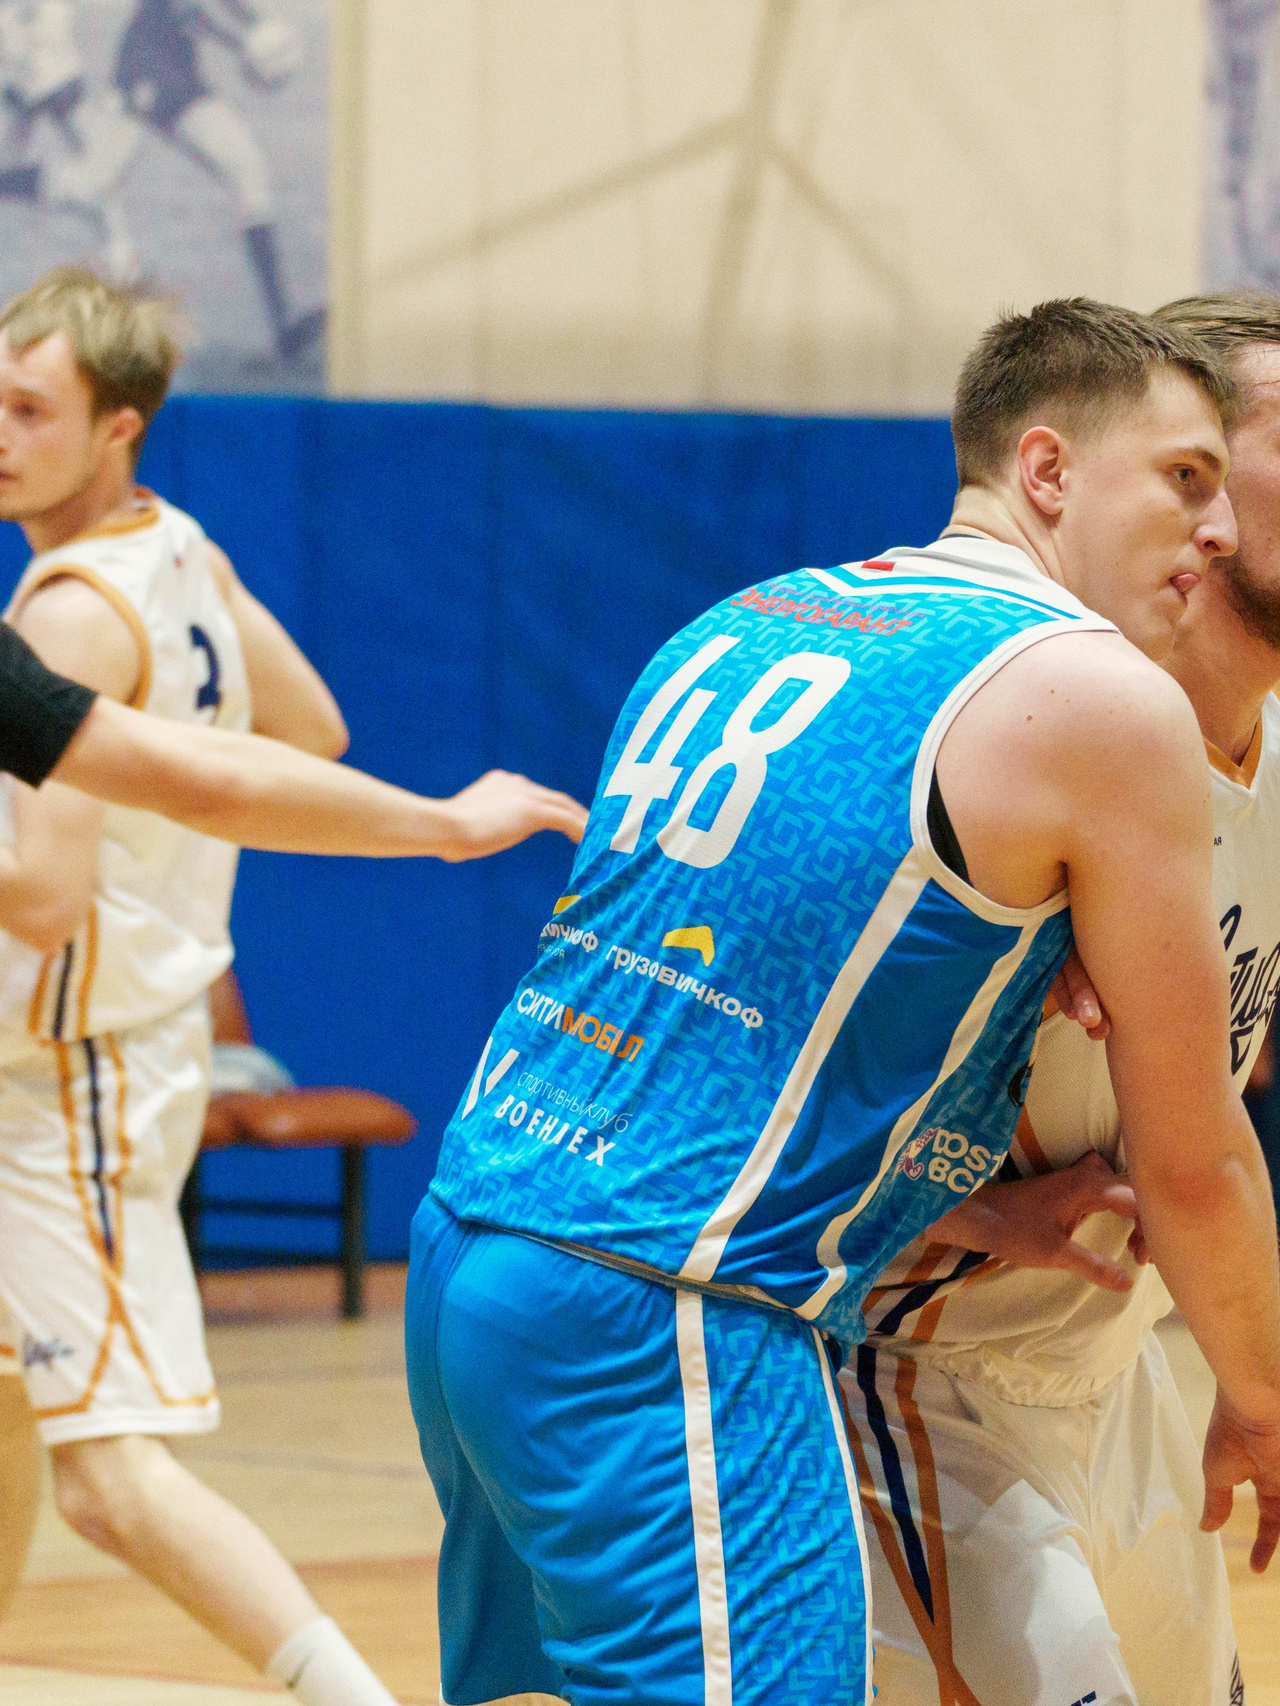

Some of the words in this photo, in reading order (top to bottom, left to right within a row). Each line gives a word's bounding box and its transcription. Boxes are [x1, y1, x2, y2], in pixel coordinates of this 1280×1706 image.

[729, 588, 913, 637] ЭНЕРГОГАРАНТ
[602, 633, 852, 869] 48
[605, 944, 764, 1029] грузовичкоф
